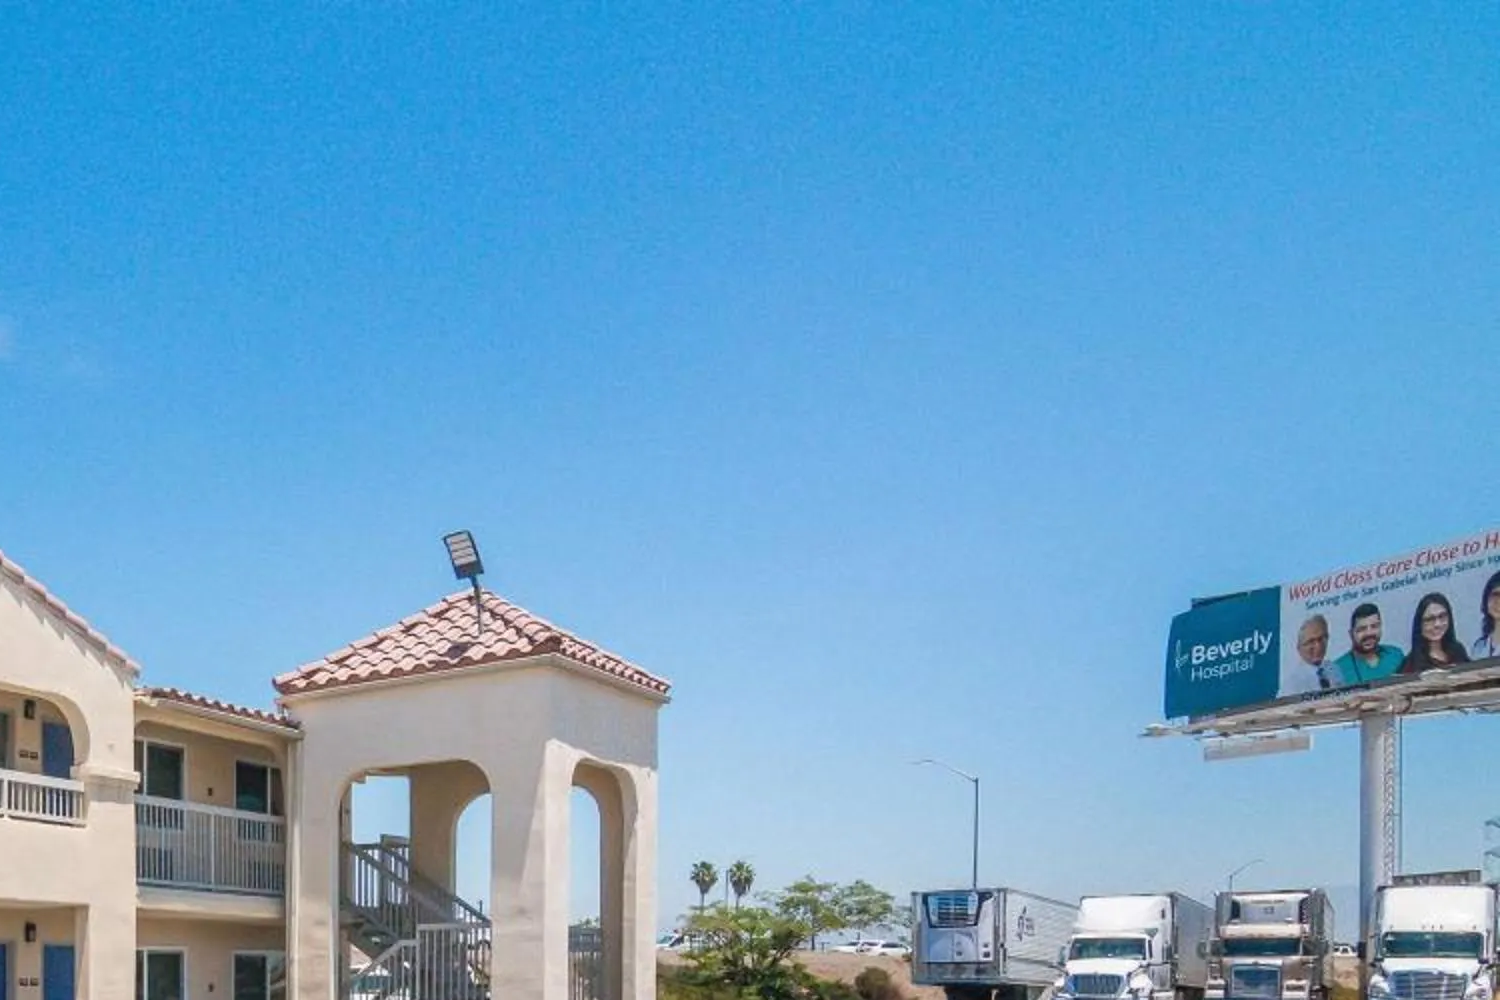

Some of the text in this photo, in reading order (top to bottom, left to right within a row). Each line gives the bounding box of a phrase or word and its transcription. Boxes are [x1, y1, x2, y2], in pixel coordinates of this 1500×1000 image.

[1289, 531, 1500, 601] World Class Care Close to H
[1304, 594, 1340, 610] Serving
[1342, 588, 1359, 601] the
[1362, 585, 1380, 597] San
[1381, 573, 1418, 592] Gabriel
[1420, 566, 1454, 582] Valley
[1191, 628, 1274, 666] Beverly
[1190, 653, 1255, 683] Hospital
